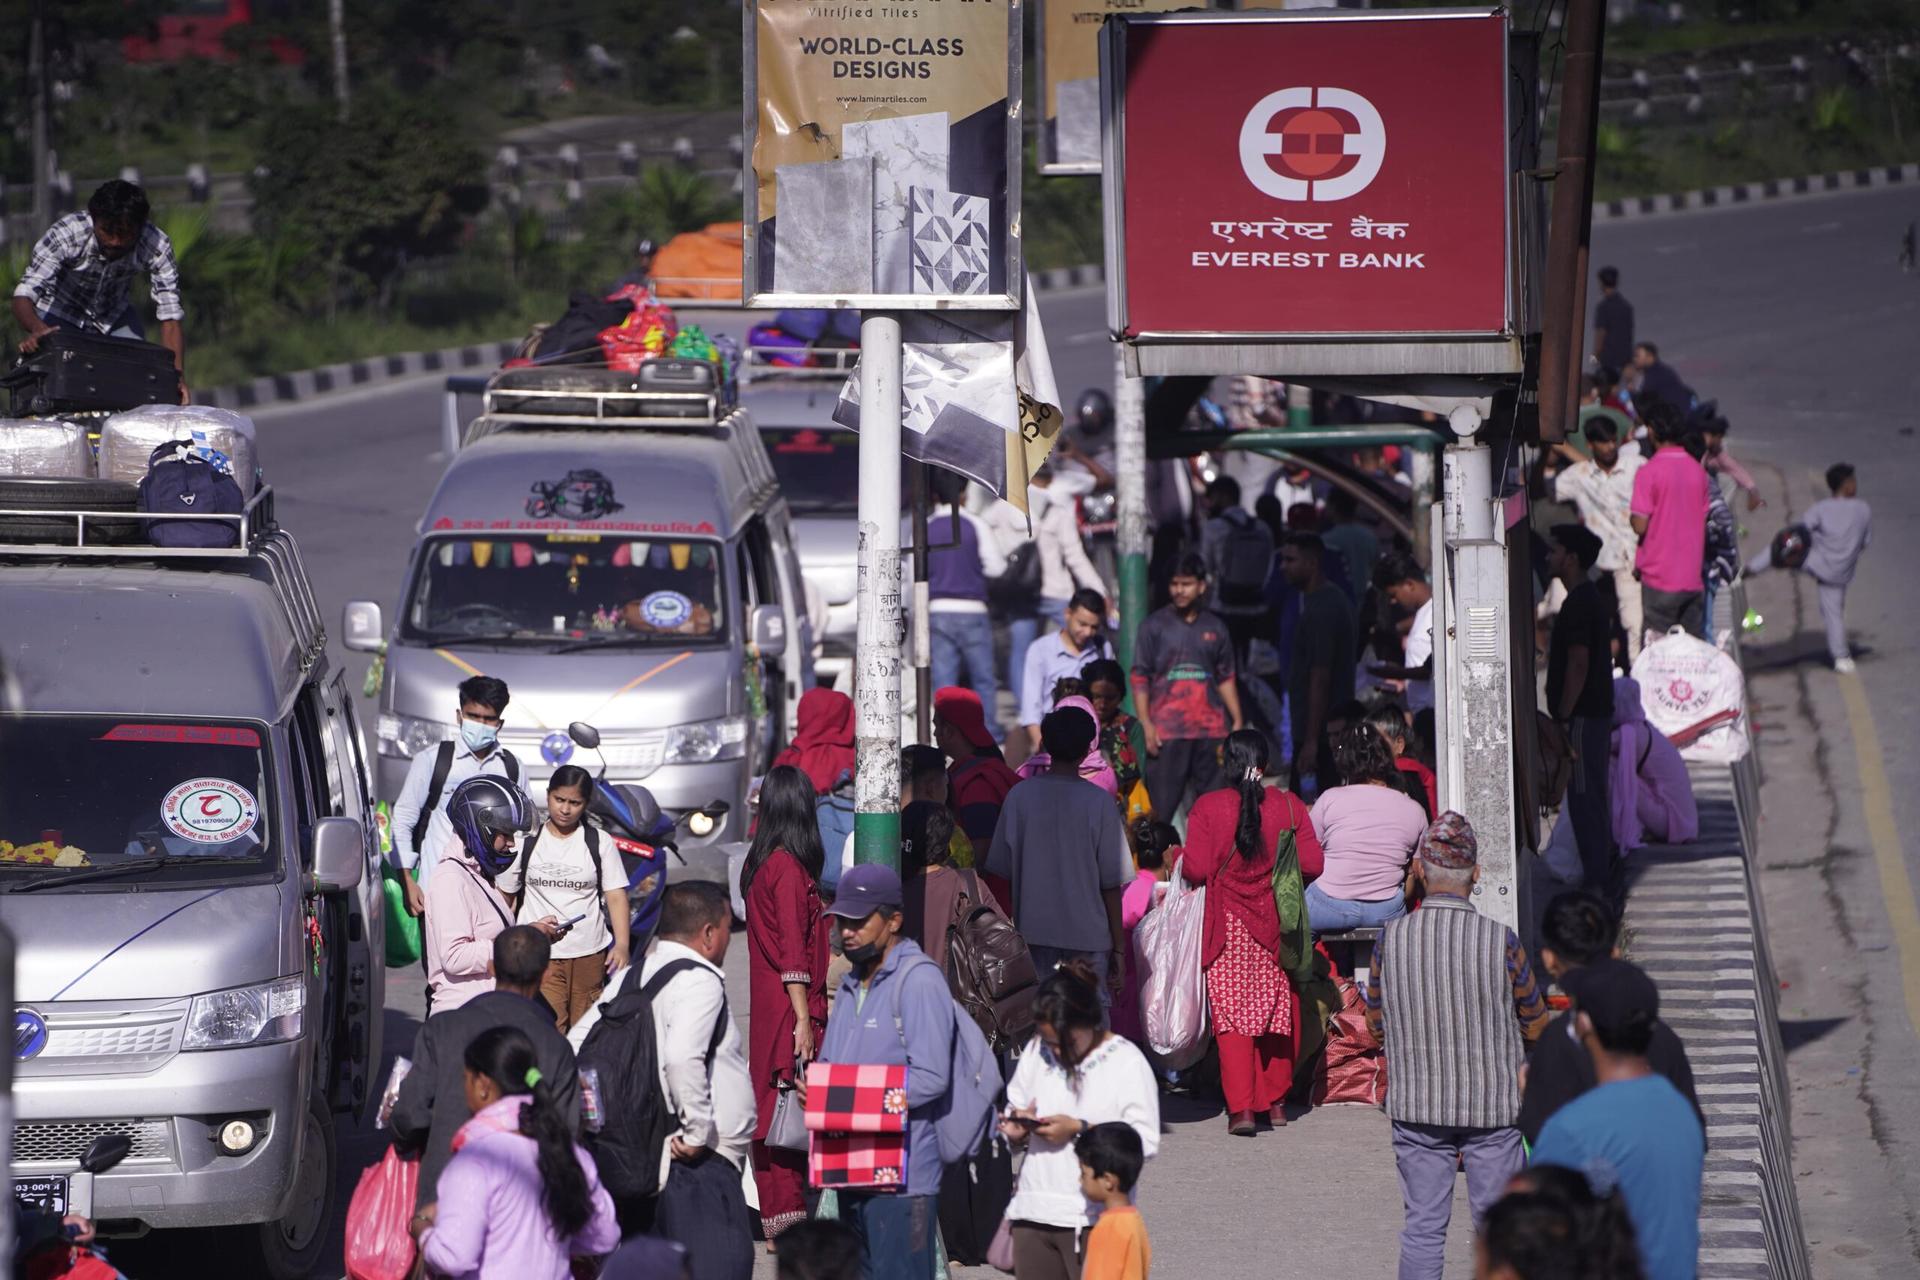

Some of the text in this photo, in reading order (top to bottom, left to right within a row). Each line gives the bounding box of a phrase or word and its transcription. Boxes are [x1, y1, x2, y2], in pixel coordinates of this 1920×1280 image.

[808, 6, 919, 20] Vitrified Tiles
[799, 37, 964, 56] WORLD-CLASS
[833, 61, 931, 79] DESIGNS
[836, 95, 927, 104] www.laminartiles.com
[1210, 215, 1409, 243] एभरेष्ट बैंक
[1192, 251, 1426, 268] EVEREST BANK
